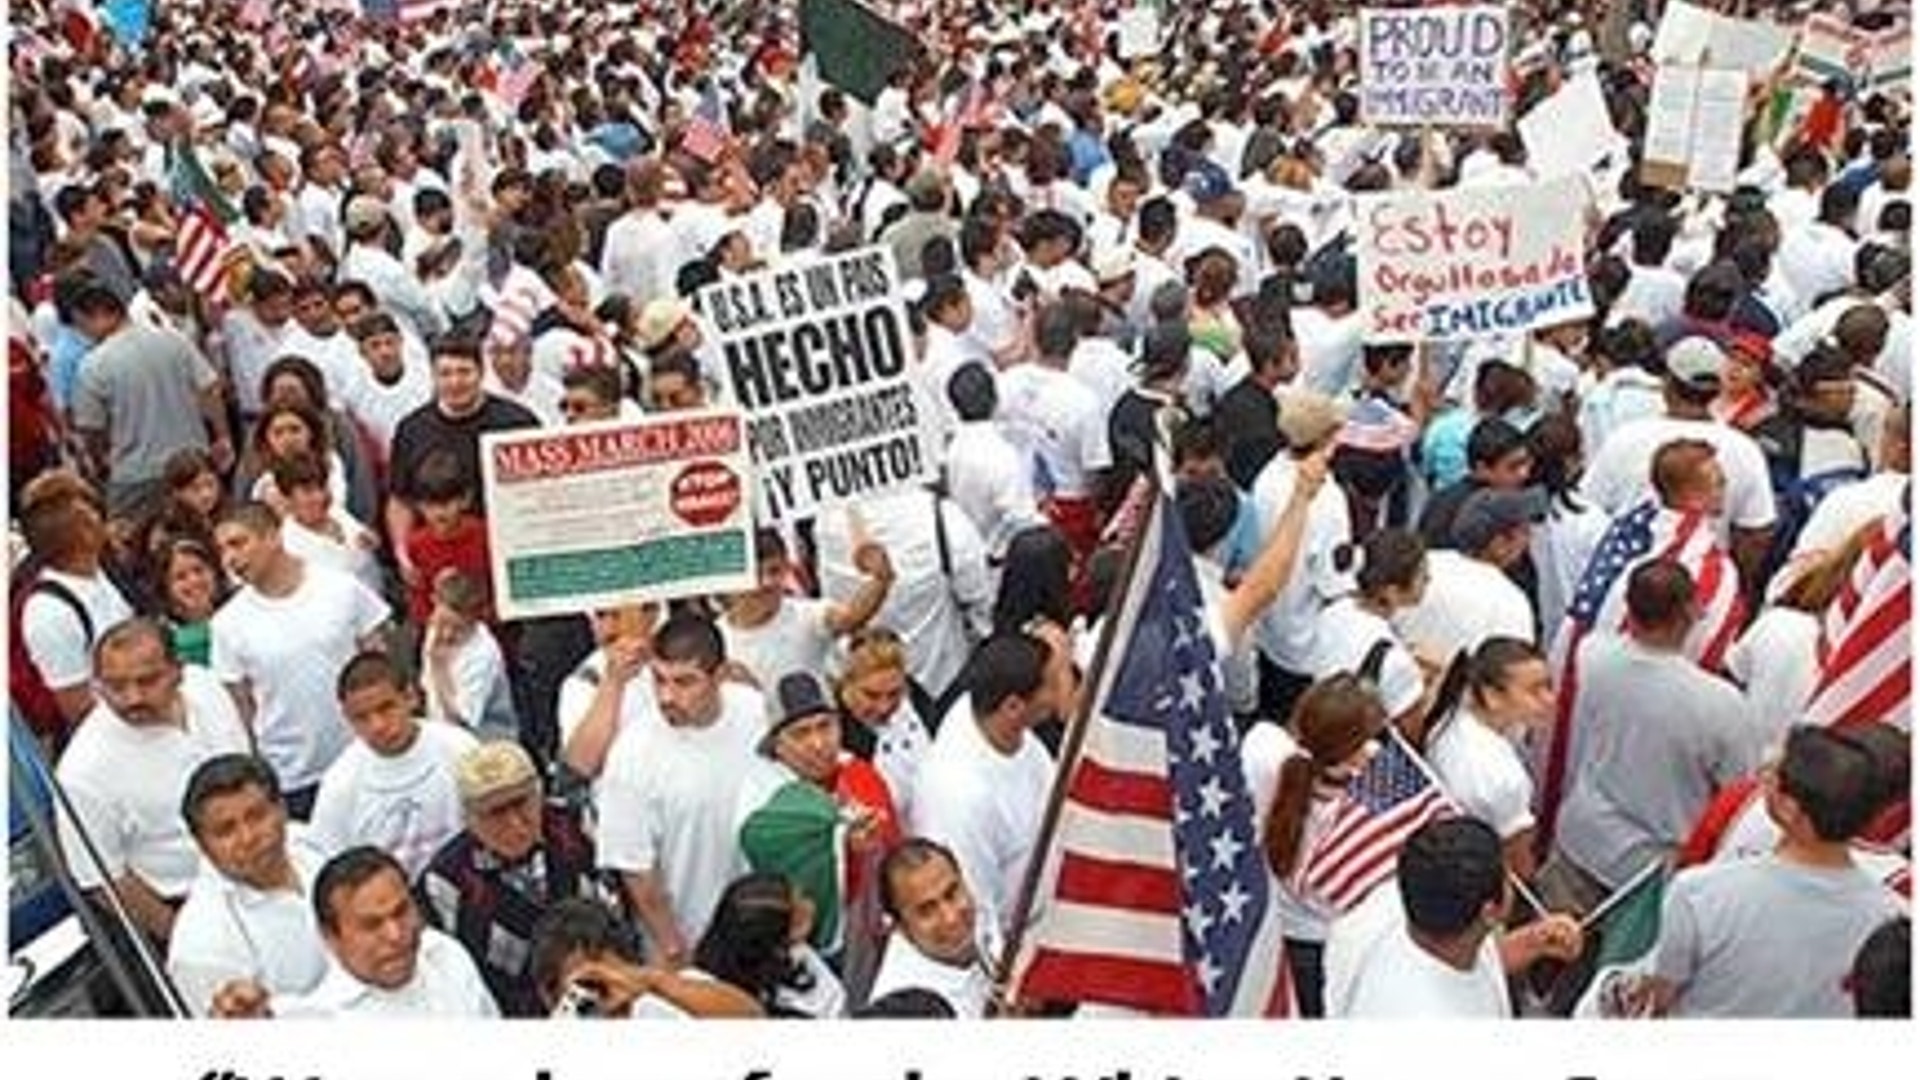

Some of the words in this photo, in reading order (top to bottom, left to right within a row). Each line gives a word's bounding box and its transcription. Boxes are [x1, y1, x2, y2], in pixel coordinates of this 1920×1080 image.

[1369, 13, 1503, 58] PROUD
[1374, 61, 1411, 84] TO
[1450, 61, 1494, 84] AN
[1371, 202, 1513, 258] Estoy
[775, 269, 805, 320] ES
[805, 263, 840, 312] UN
[1373, 303, 1423, 333] Ser
[722, 304, 906, 410] HECHO
[498, 440, 572, 476] MASS
[574, 427, 677, 467] MARCH
[805, 434, 924, 502] PUNTO!
